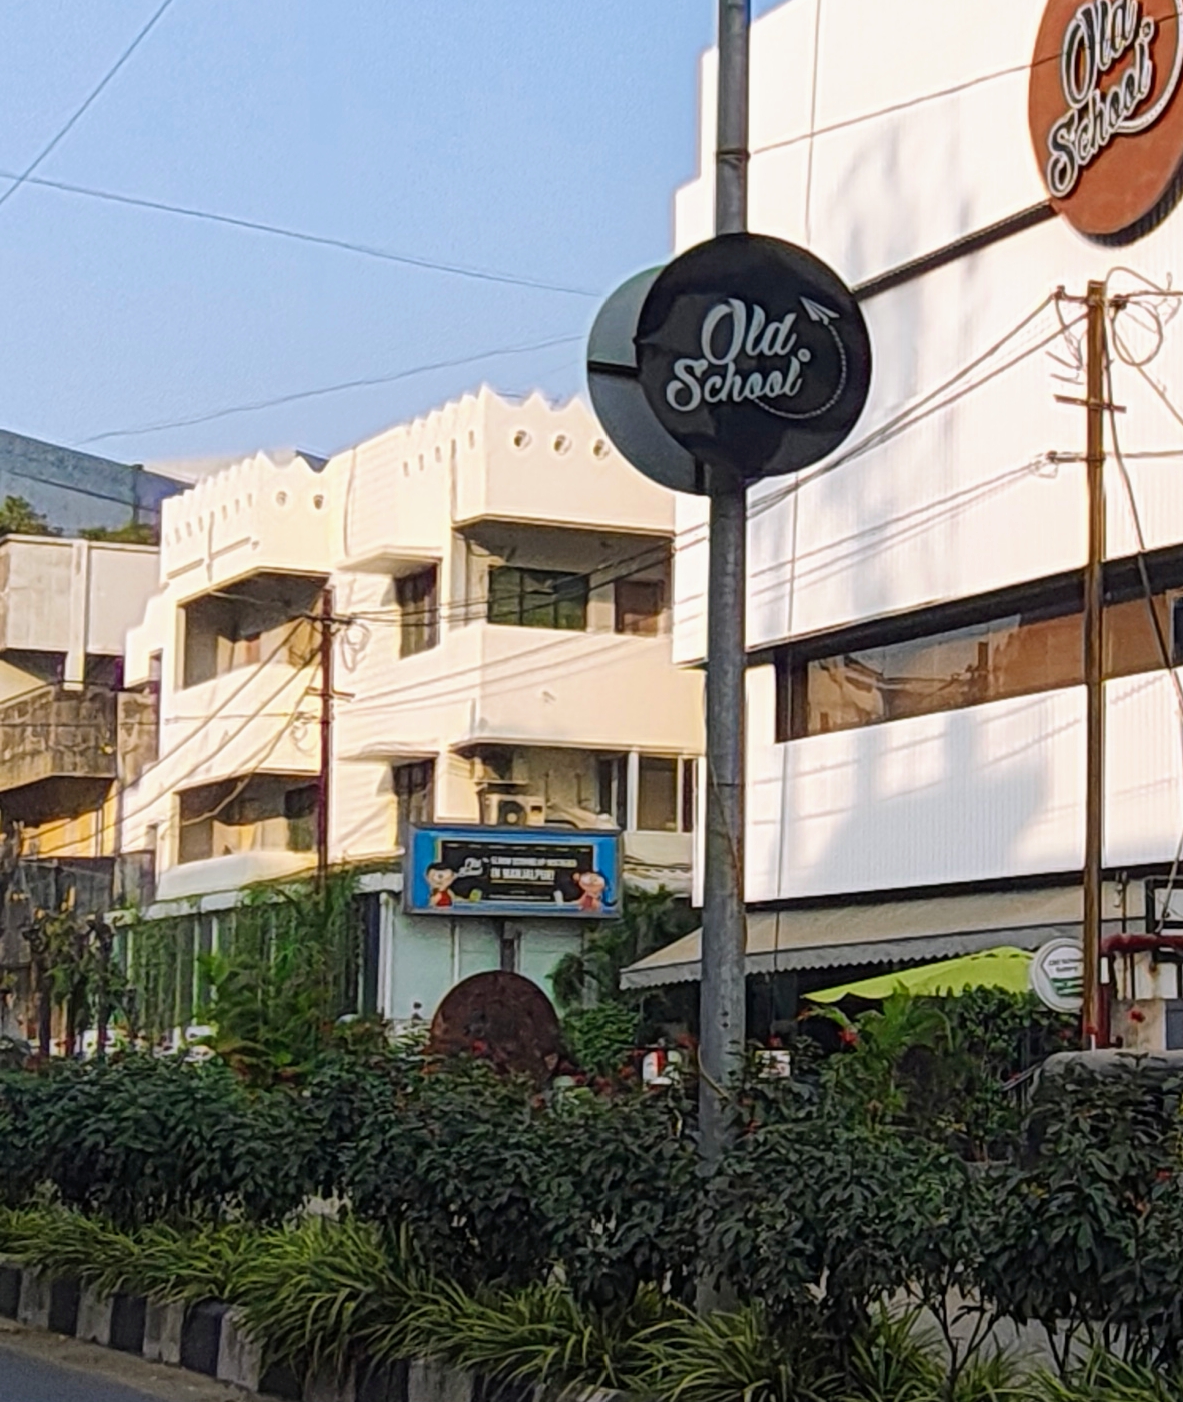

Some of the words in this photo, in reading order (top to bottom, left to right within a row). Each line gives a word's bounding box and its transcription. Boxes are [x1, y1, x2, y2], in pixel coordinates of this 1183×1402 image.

[1047, 39, 1153, 197] School
[701, 297, 797, 365] Old
[666, 356, 802, 412] School
